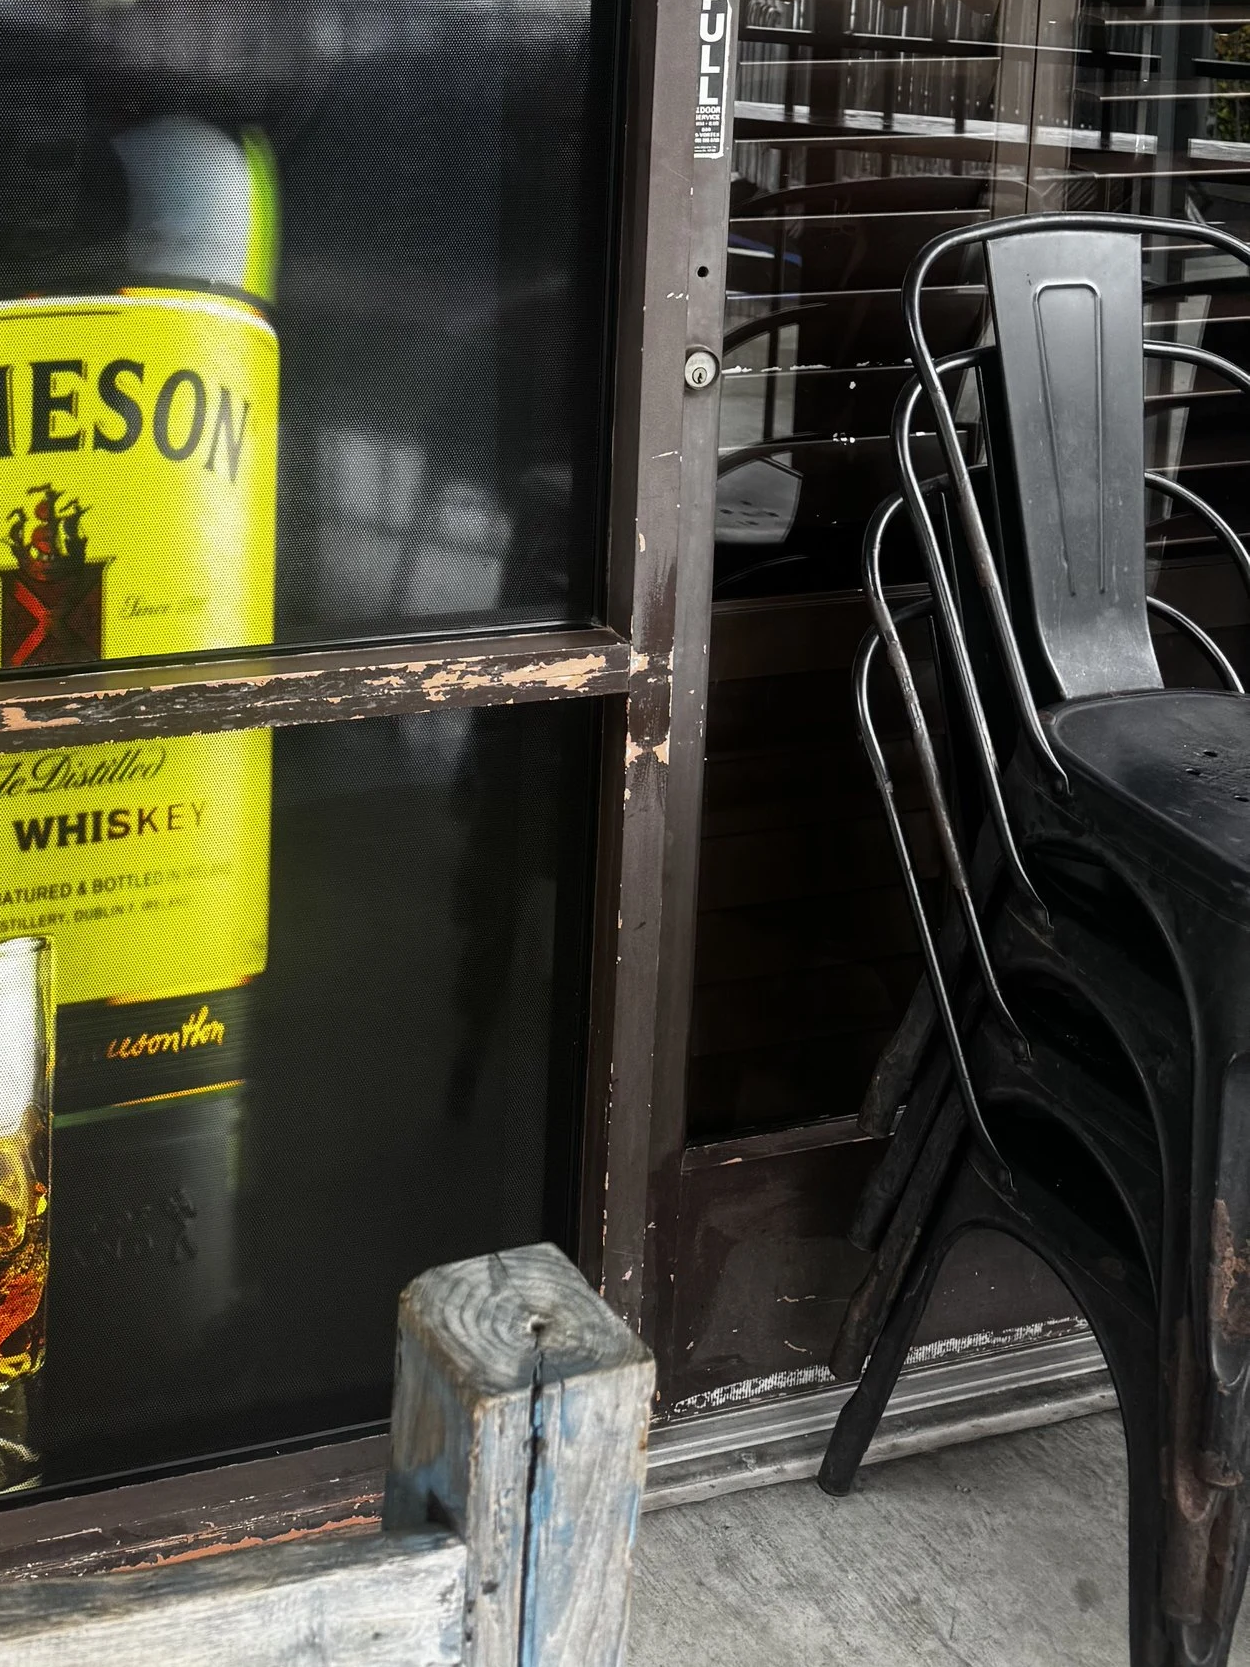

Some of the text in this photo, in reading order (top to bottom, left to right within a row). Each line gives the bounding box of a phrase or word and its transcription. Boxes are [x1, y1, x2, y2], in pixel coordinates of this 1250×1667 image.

[28, 746, 167, 795] Distilled
[13, 802, 207, 852] WHISKEY
[76, 879, 88, 896] &
[91, 869, 164, 895] BOTTLED
